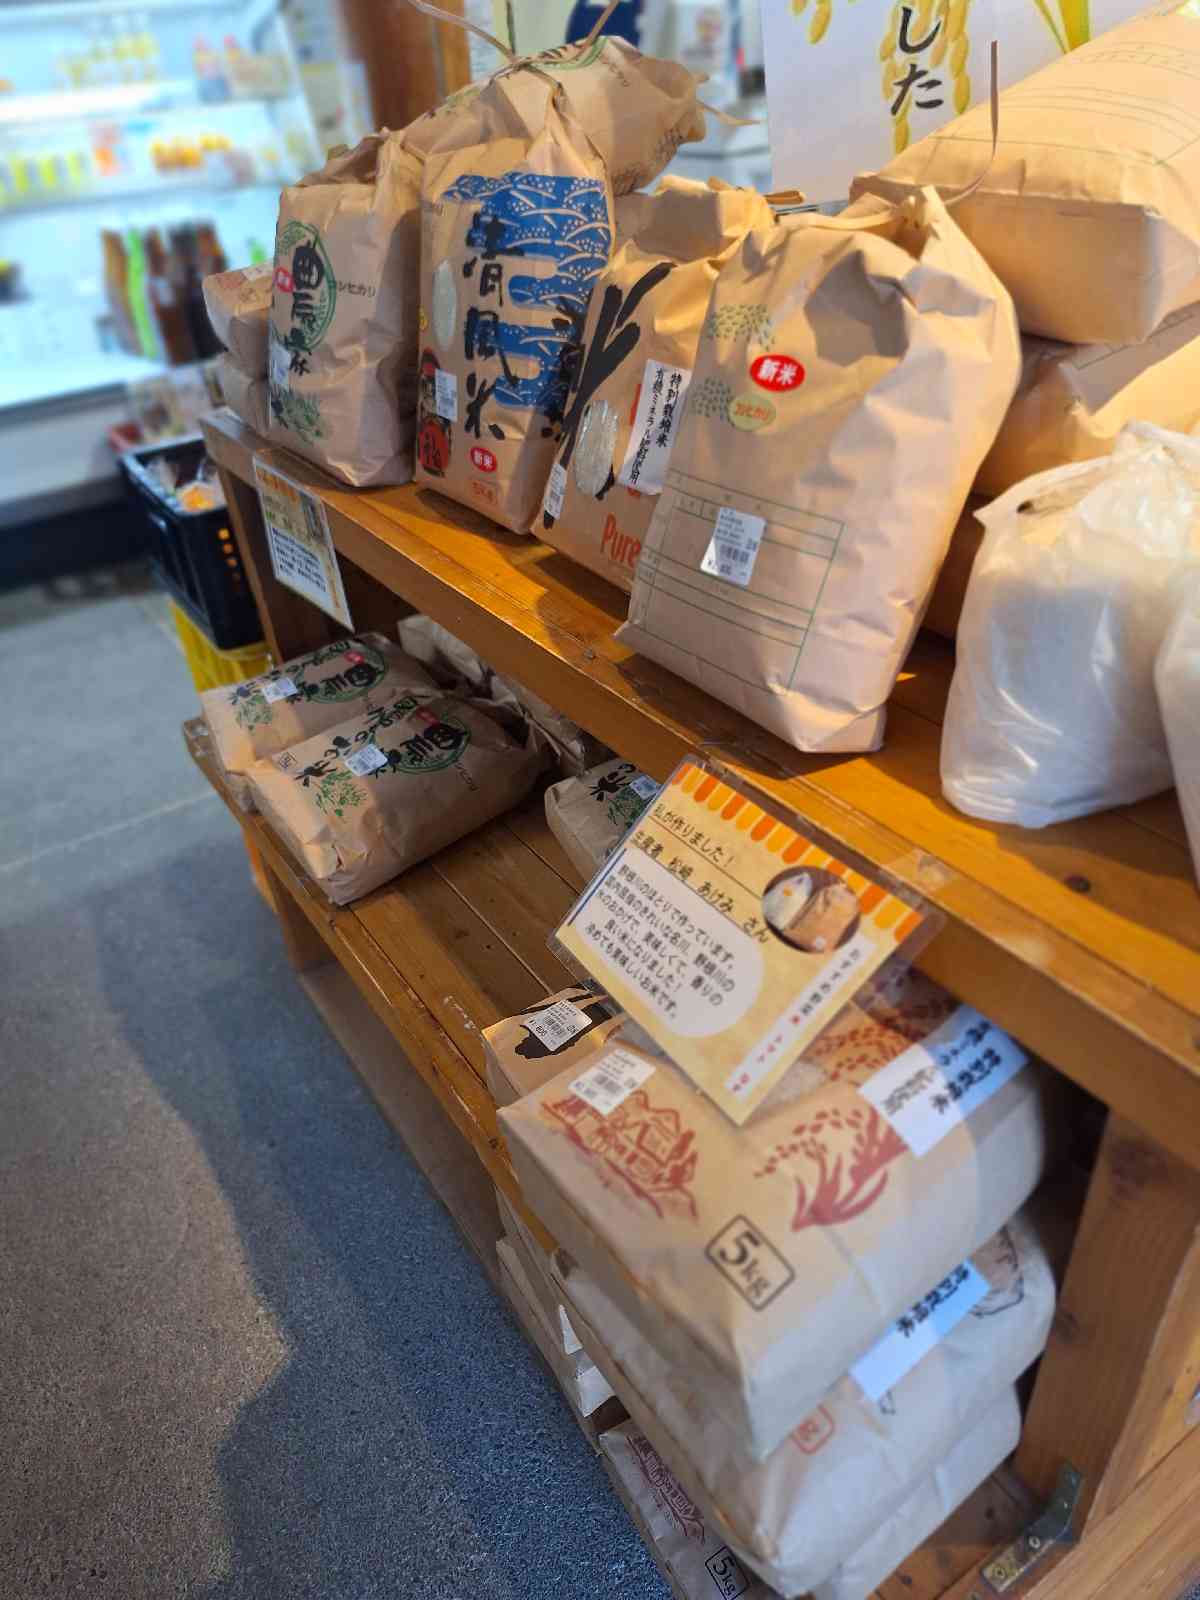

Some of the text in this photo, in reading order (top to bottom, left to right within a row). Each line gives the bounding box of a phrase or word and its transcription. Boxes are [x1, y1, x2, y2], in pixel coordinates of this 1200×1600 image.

[890, 5, 944, 116] した
[757, 357, 797, 385] 新米
[630, 831, 664, 860] 生産者
[698, 881, 734, 913] あけみ
[742, 916, 769, 944] さん
[717, 1229, 772, 1296] 5kg
[713, 1556, 739, 1597] 5kg
